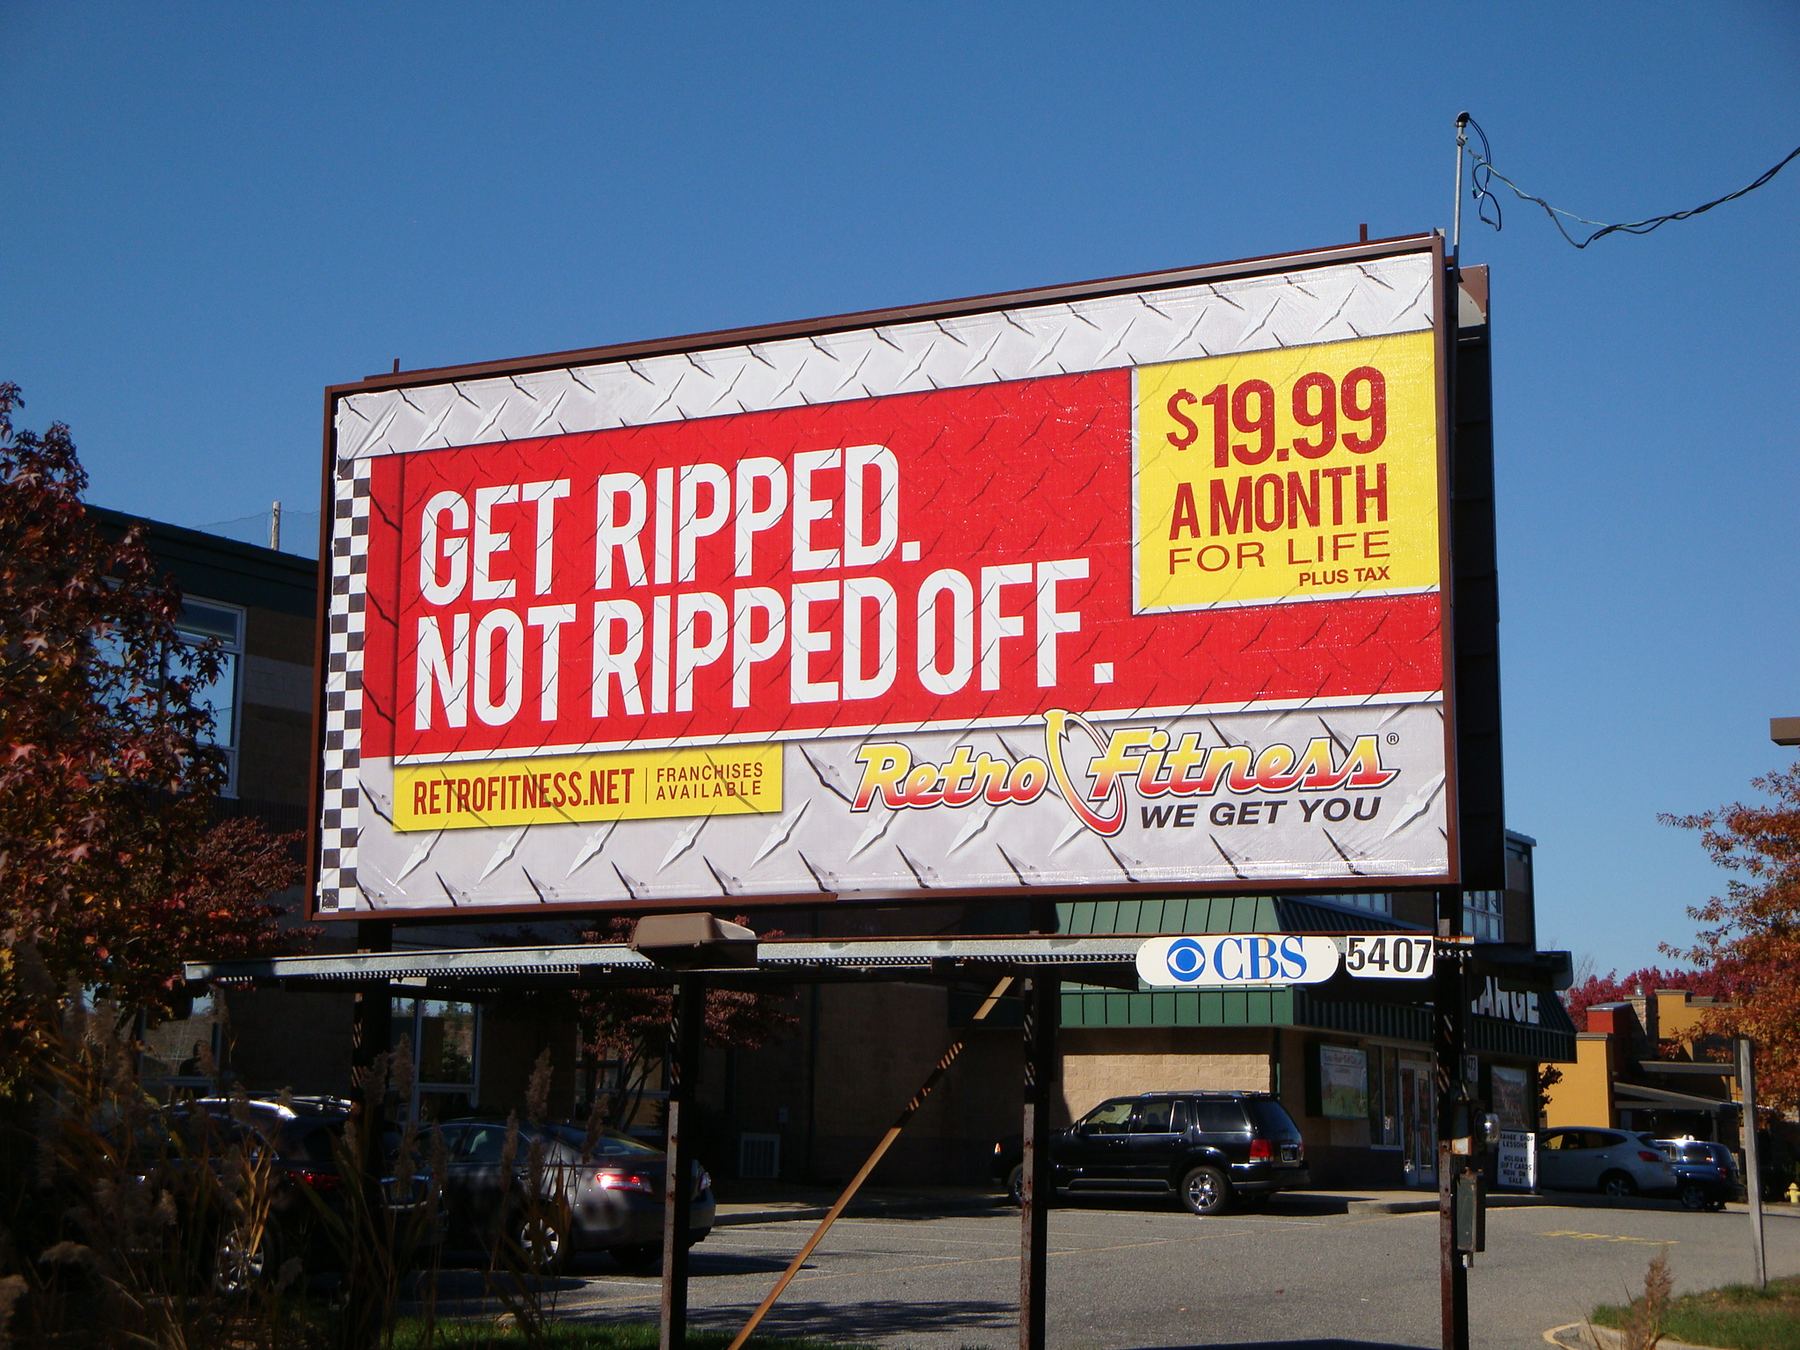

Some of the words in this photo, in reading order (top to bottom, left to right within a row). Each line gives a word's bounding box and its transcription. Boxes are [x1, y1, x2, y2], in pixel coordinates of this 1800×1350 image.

[1166, 365, 1387, 469] $19.99
[419, 478, 571, 606] GET
[594, 443, 921, 590] RIPPED.
[1169, 482, 1201, 541] A
[1209, 463, 1389, 537] MONTH
[1169, 541, 1266, 575] FOR
[1287, 530, 1391, 565] LIFE
[1299, 568, 1349, 587] PLUS
[1354, 565, 1391, 583] TAX
[415, 603, 577, 731] NOT
[591, 576, 898, 718] RIPPED
[917, 557, 1114, 695] OFF.
[413, 768, 635, 816] RETROFITNESS.NET
[656, 761, 764, 783] FRANCHISES
[656, 780, 762, 801] AVAILABLE
[850, 741, 1050, 813] Retro
[1086, 725, 1401, 802] Fitness
[1140, 803, 1198, 829] WE
[1209, 800, 1287, 826] GET
[1299, 796, 1381, 823] YOU
[1213, 935, 1307, 981] CBS
[1347, 937, 1432, 973] 5407
[1471, 976, 1539, 1024] ANGE
